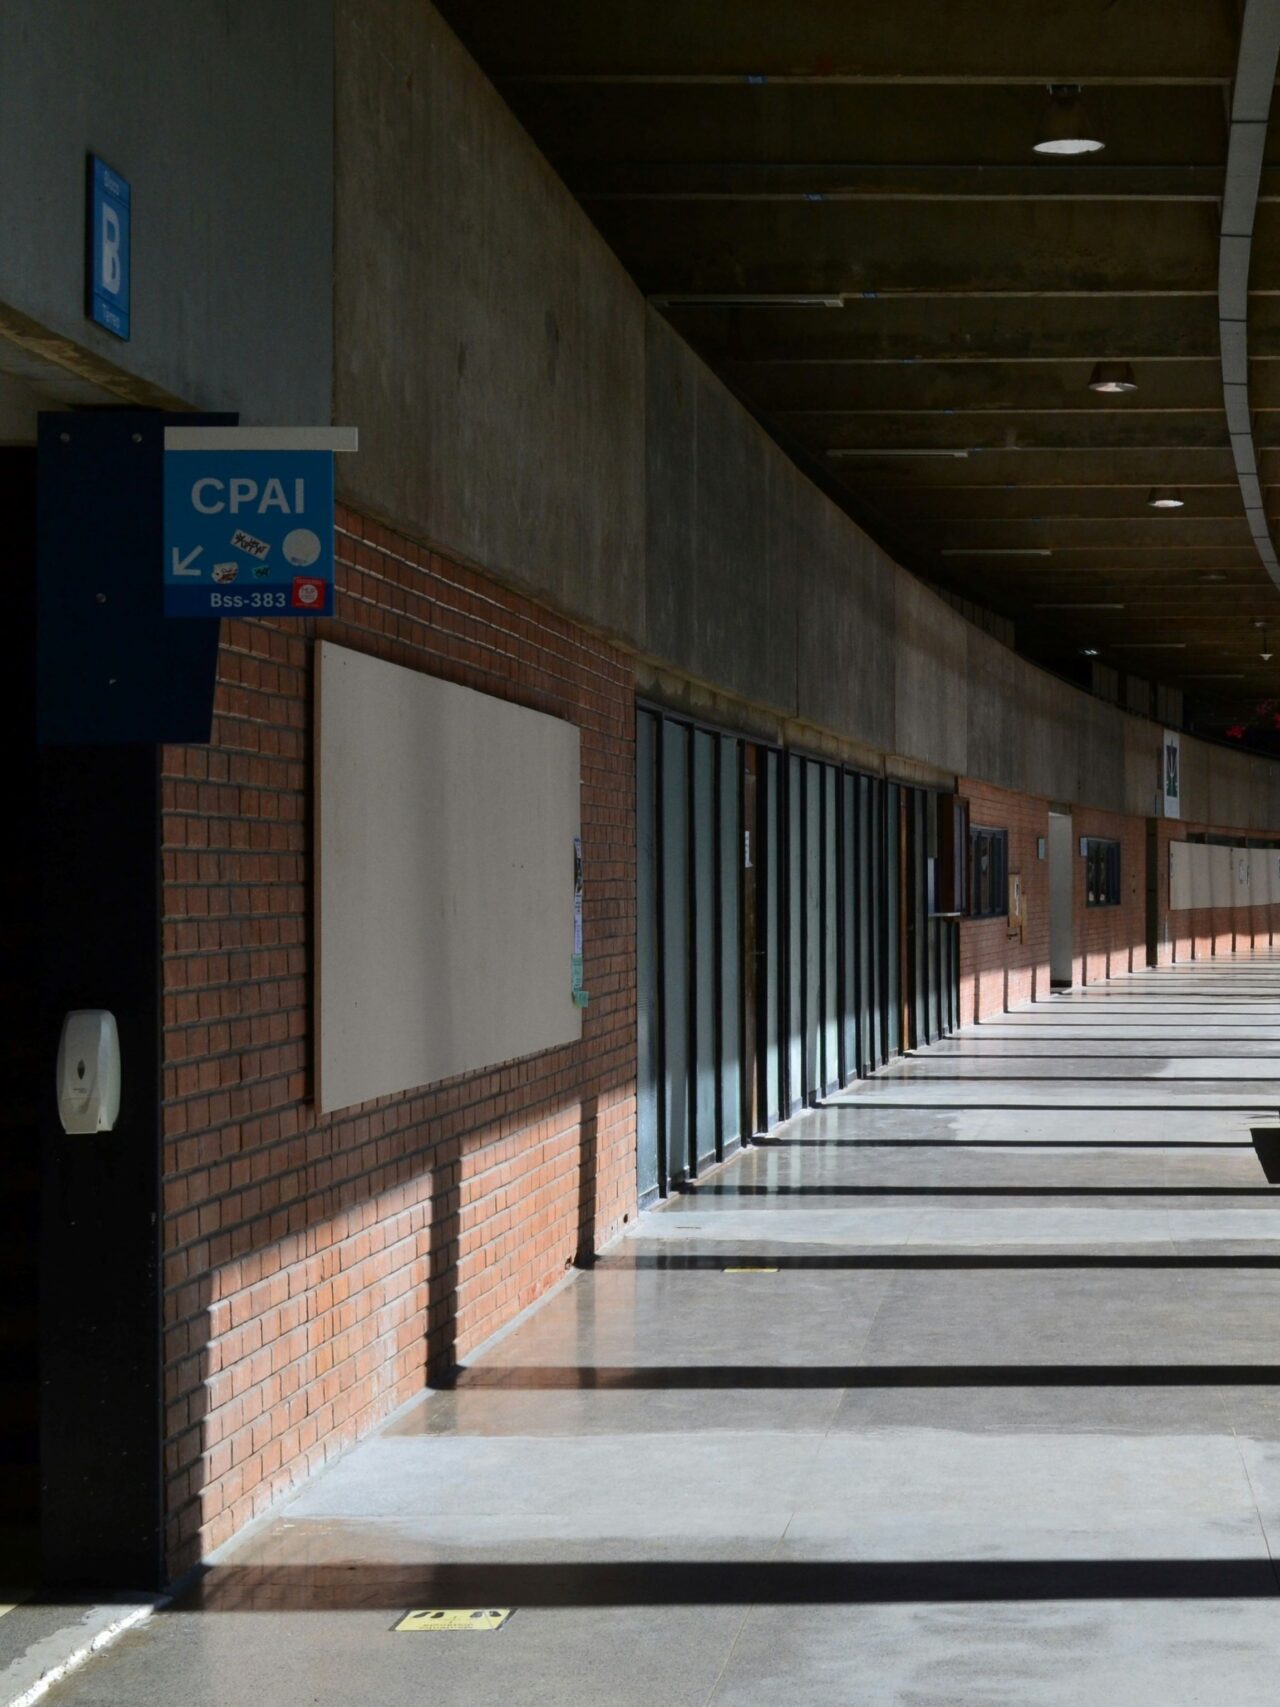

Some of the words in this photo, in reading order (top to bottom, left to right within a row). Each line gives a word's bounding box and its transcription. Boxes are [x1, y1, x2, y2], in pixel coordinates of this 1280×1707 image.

[102, 202, 121, 295] B
[190, 477, 305, 515] CPAI
[210, 592, 287, 608] Bss-383
